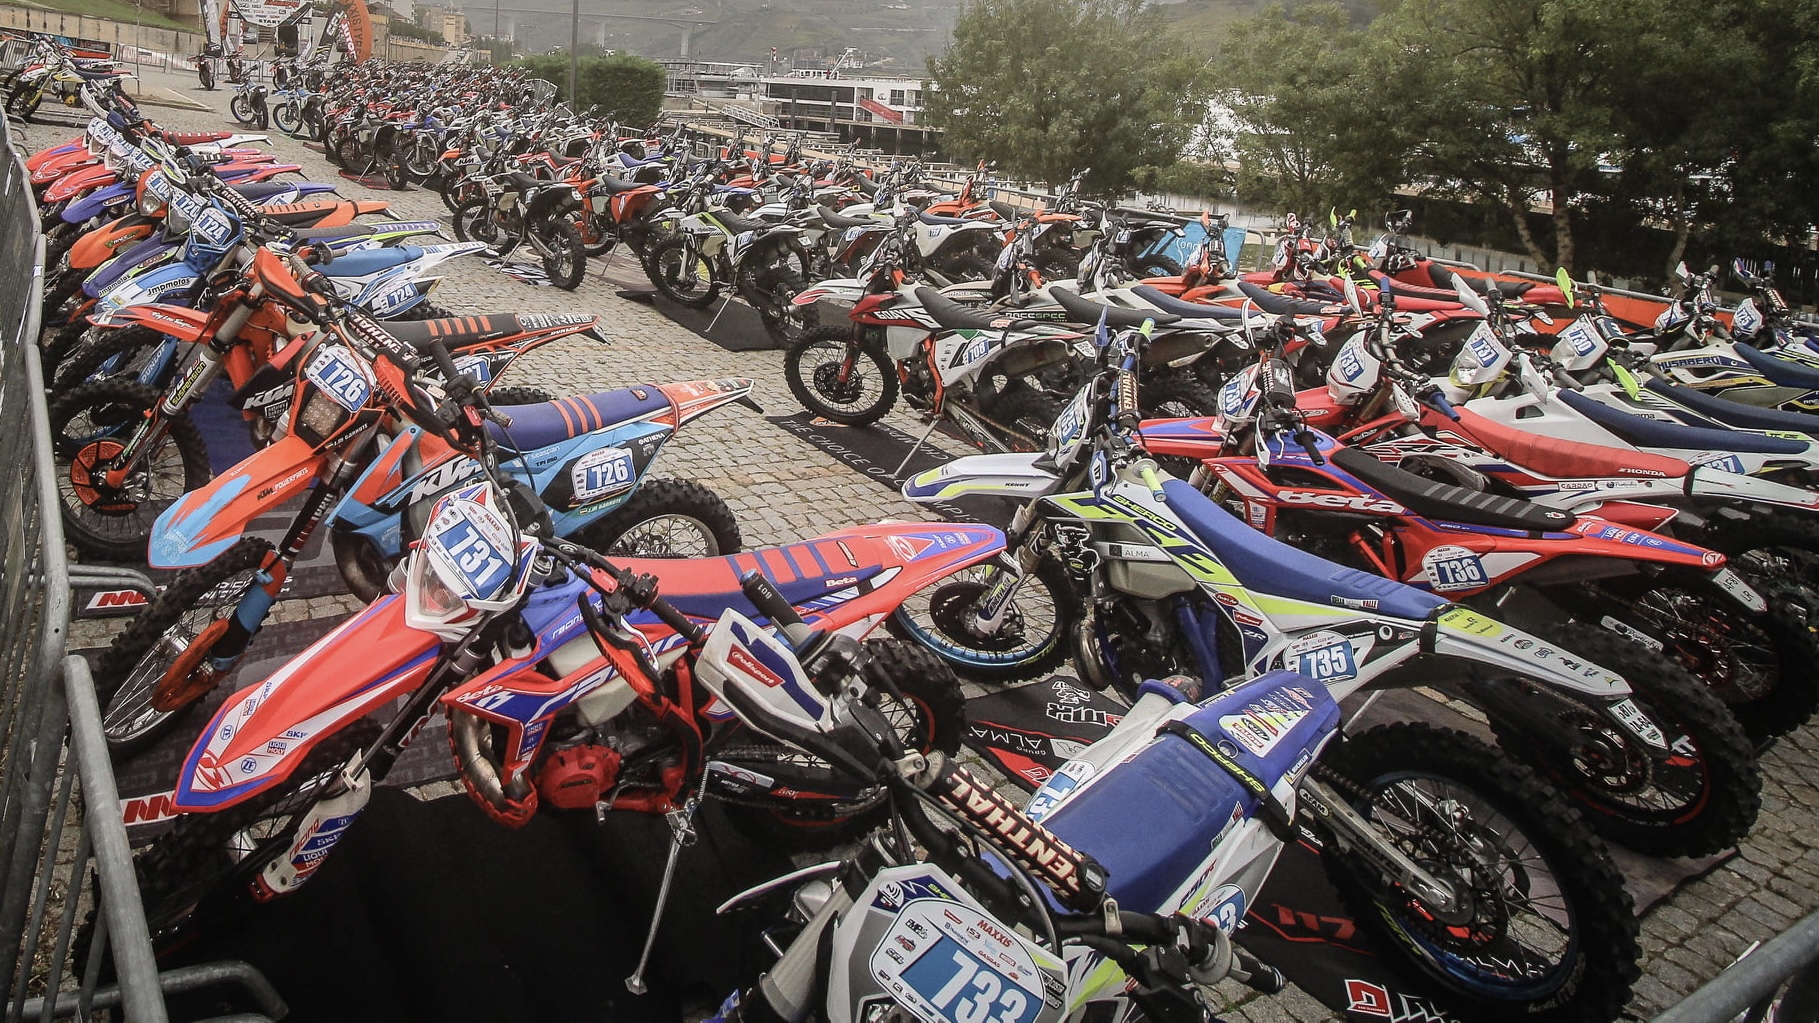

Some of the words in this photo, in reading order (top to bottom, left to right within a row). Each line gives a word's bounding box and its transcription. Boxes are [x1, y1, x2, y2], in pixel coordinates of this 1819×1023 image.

[204, 217, 226, 240] 724
[147, 277, 190, 296] Jmpmotos
[390, 284, 415, 305] 724
[1005, 312, 1066, 320] RACESPEC
[969, 343, 987, 360] 708
[324, 361, 366, 403] 726
[242, 384, 294, 410] KTM
[779, 419, 812, 434] THE
[808, 433, 872, 466] CHOICE
[408, 454, 484, 506] KTM
[591, 459, 630, 488] 726
[1625, 467, 1667, 478] HONDA
[1112, 494, 1177, 532] SHERCO
[448, 525, 505, 587] 731
[1123, 549, 1150, 559] ALMA
[826, 576, 858, 588] Beta
[1439, 558, 1482, 584] 736
[732, 651, 775, 685] Polisport
[1305, 646, 1348, 680] 735
[456, 684, 504, 703] Beta
[269, 740, 288, 750] LIQUI
[285, 730, 308, 739] SKF
[970, 725, 1042, 749] ALMA
[267, 747, 286, 756] MOLY
[1190, 732, 1266, 793] SHERCO
[242, 760, 257, 771] ZF
[316, 833, 342, 846] SKF
[302, 849, 329, 862] LIQUI
[976, 919, 1014, 948] MAXXIS
[930, 949, 1028, 1023] 733
